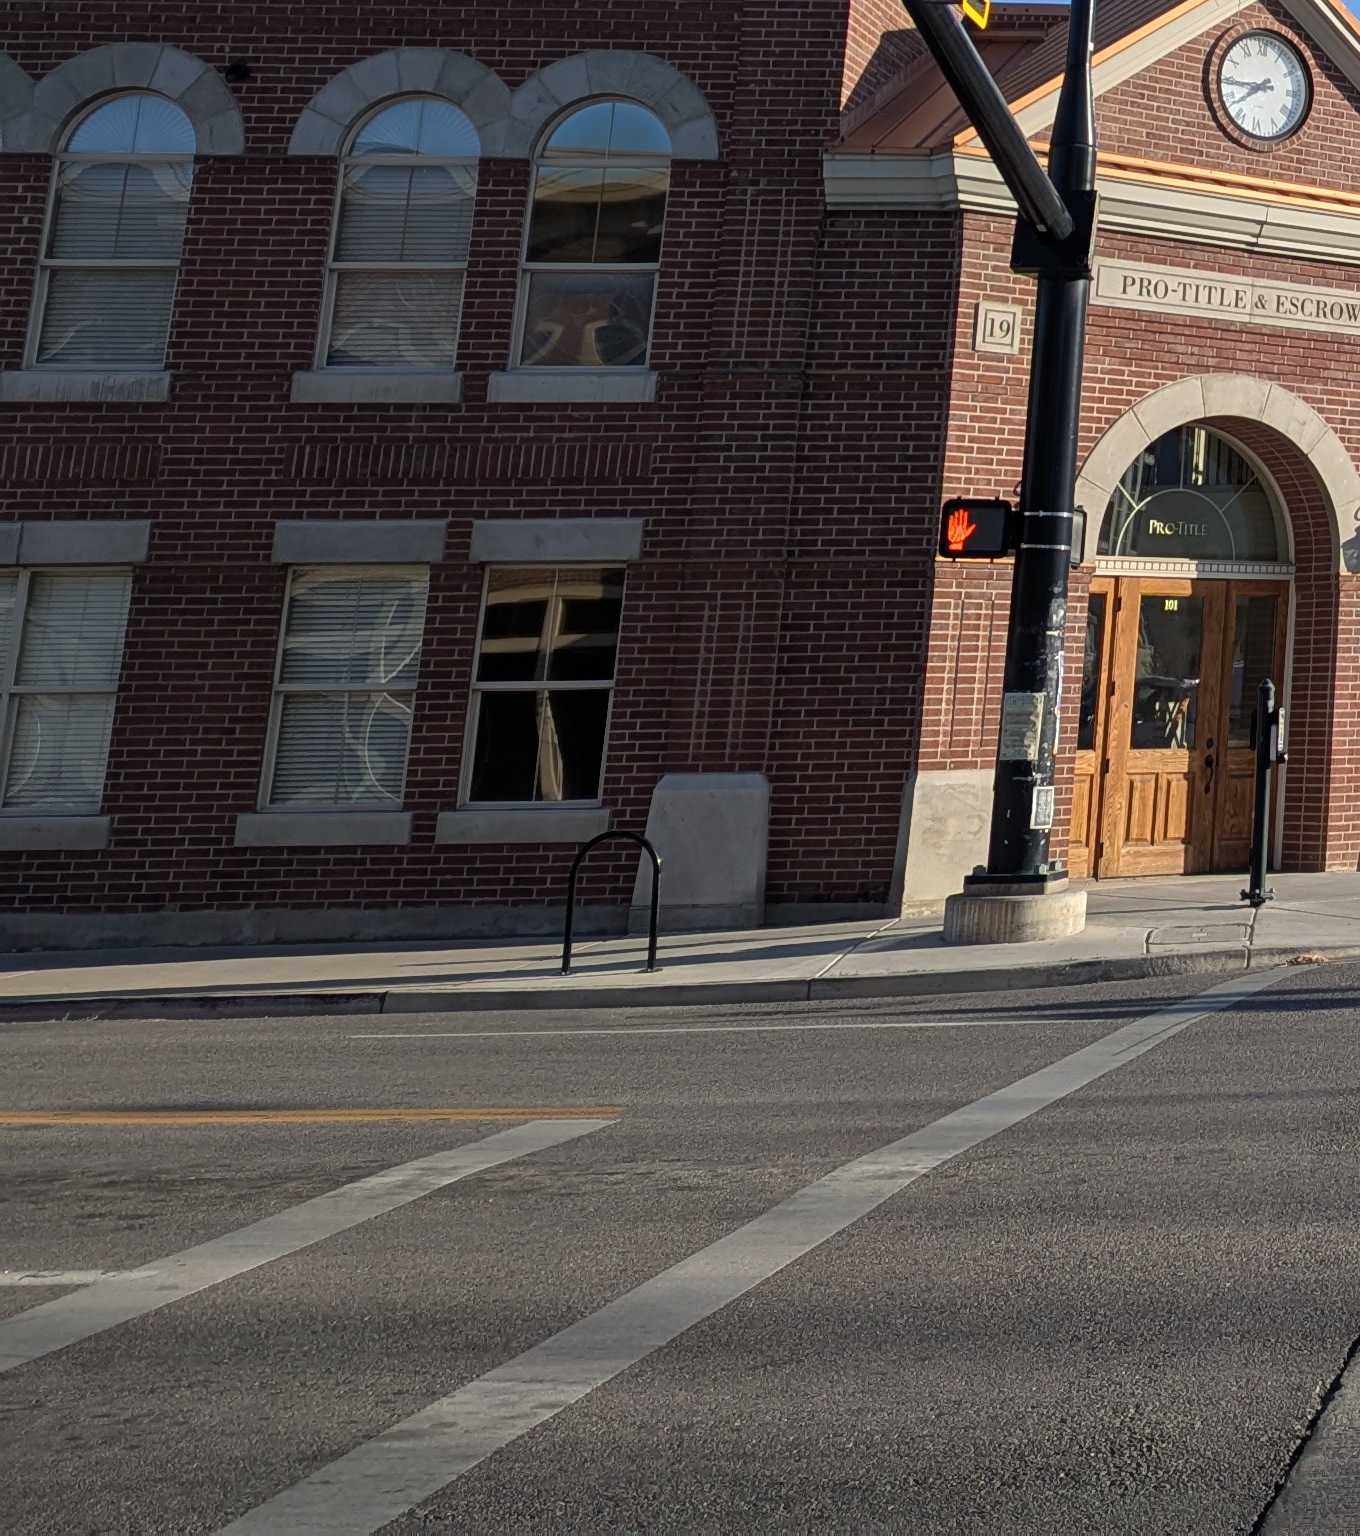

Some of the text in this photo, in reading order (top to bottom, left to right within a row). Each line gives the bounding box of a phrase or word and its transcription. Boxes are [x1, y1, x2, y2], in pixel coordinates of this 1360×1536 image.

[1119, 274, 1248, 310] PRO-TITLE
[1254, 293, 1268, 311] &
[986, 317, 1011, 339] 19
[1164, 599, 1178, 612] 101
